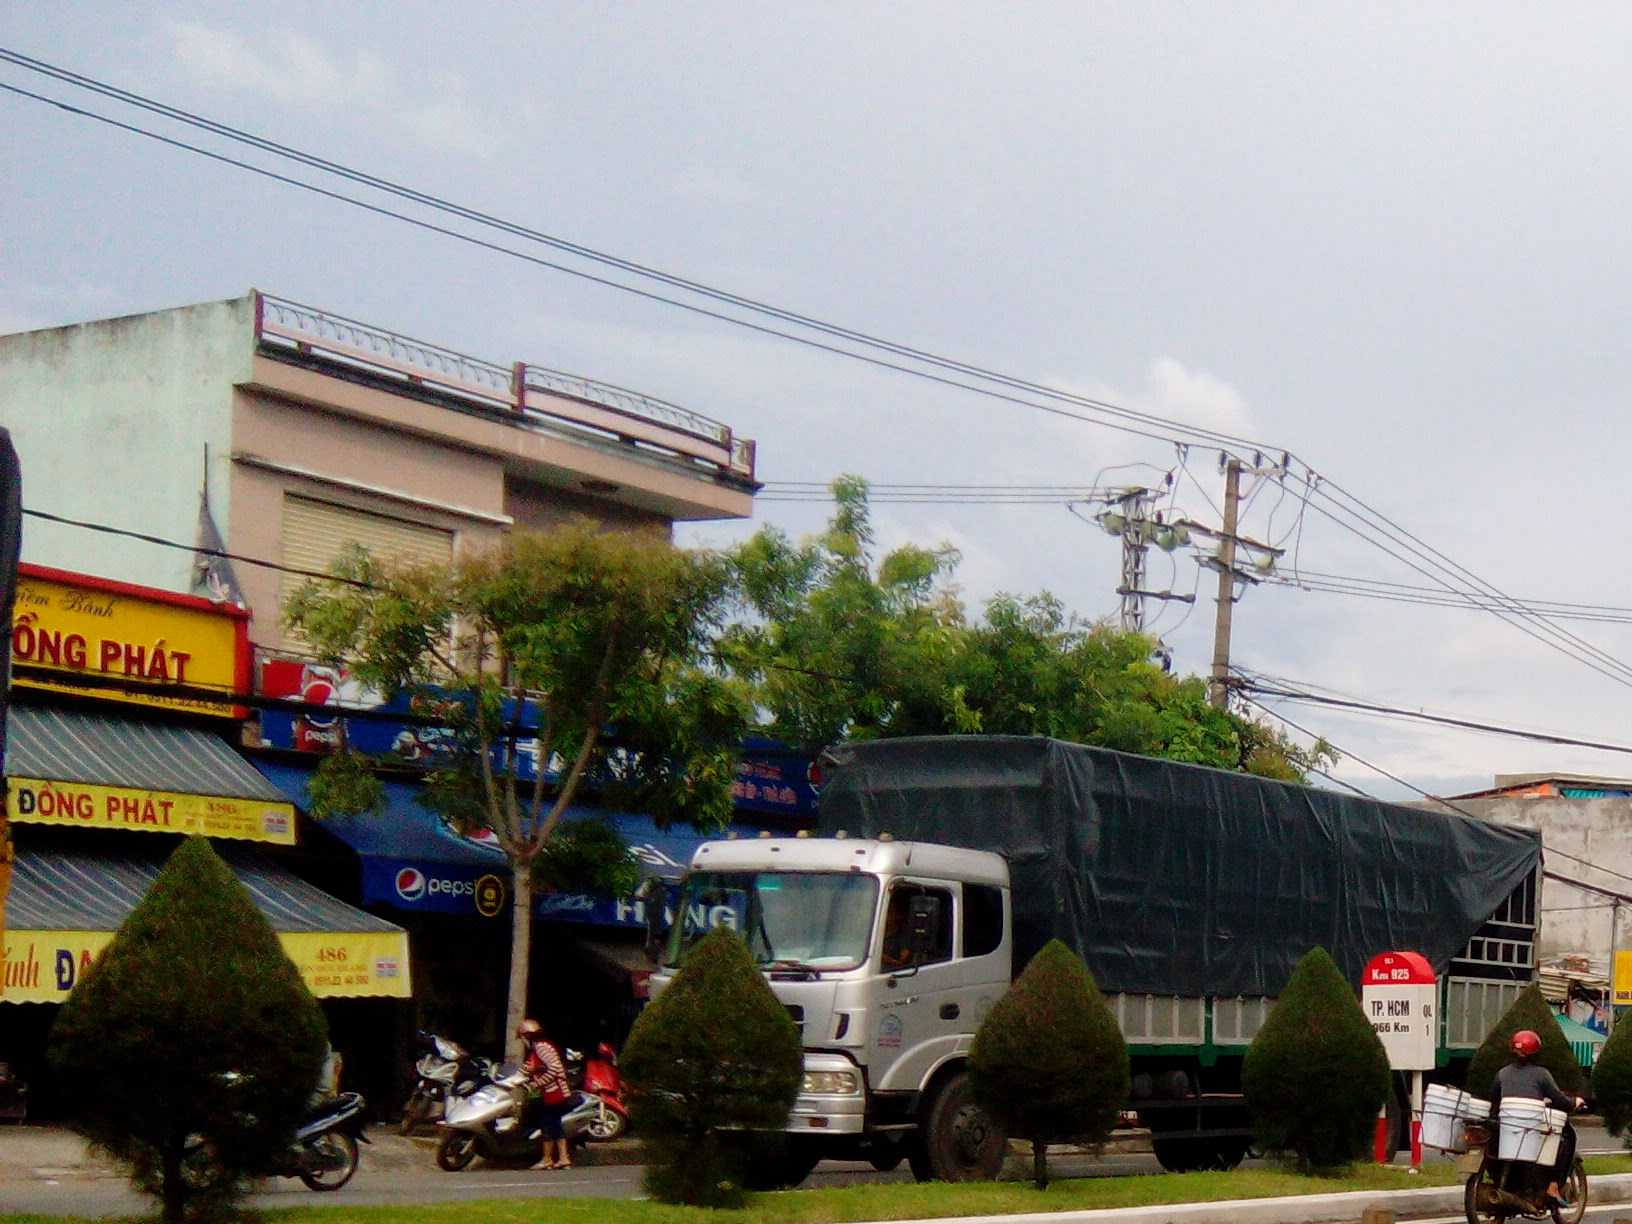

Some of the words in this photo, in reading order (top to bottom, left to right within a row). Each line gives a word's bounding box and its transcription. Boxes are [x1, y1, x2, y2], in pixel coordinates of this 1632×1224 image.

[12, 611, 87, 668] ỒNG
[100, 638, 192, 684] PHÁT
[17, 782, 95, 820] ĐỒNG
[105, 793, 175, 827] PHÁT
[427, 877, 474, 898] peps
[316, 947, 348, 962] 486
[1371, 968, 1389, 980] Km
[1371, 1000, 1385, 1017] TP.
[1387, 1000, 1410, 1017] HCM
[1423, 1005, 1432, 1018] QL
[1394, 1022, 1409, 1032] Km
